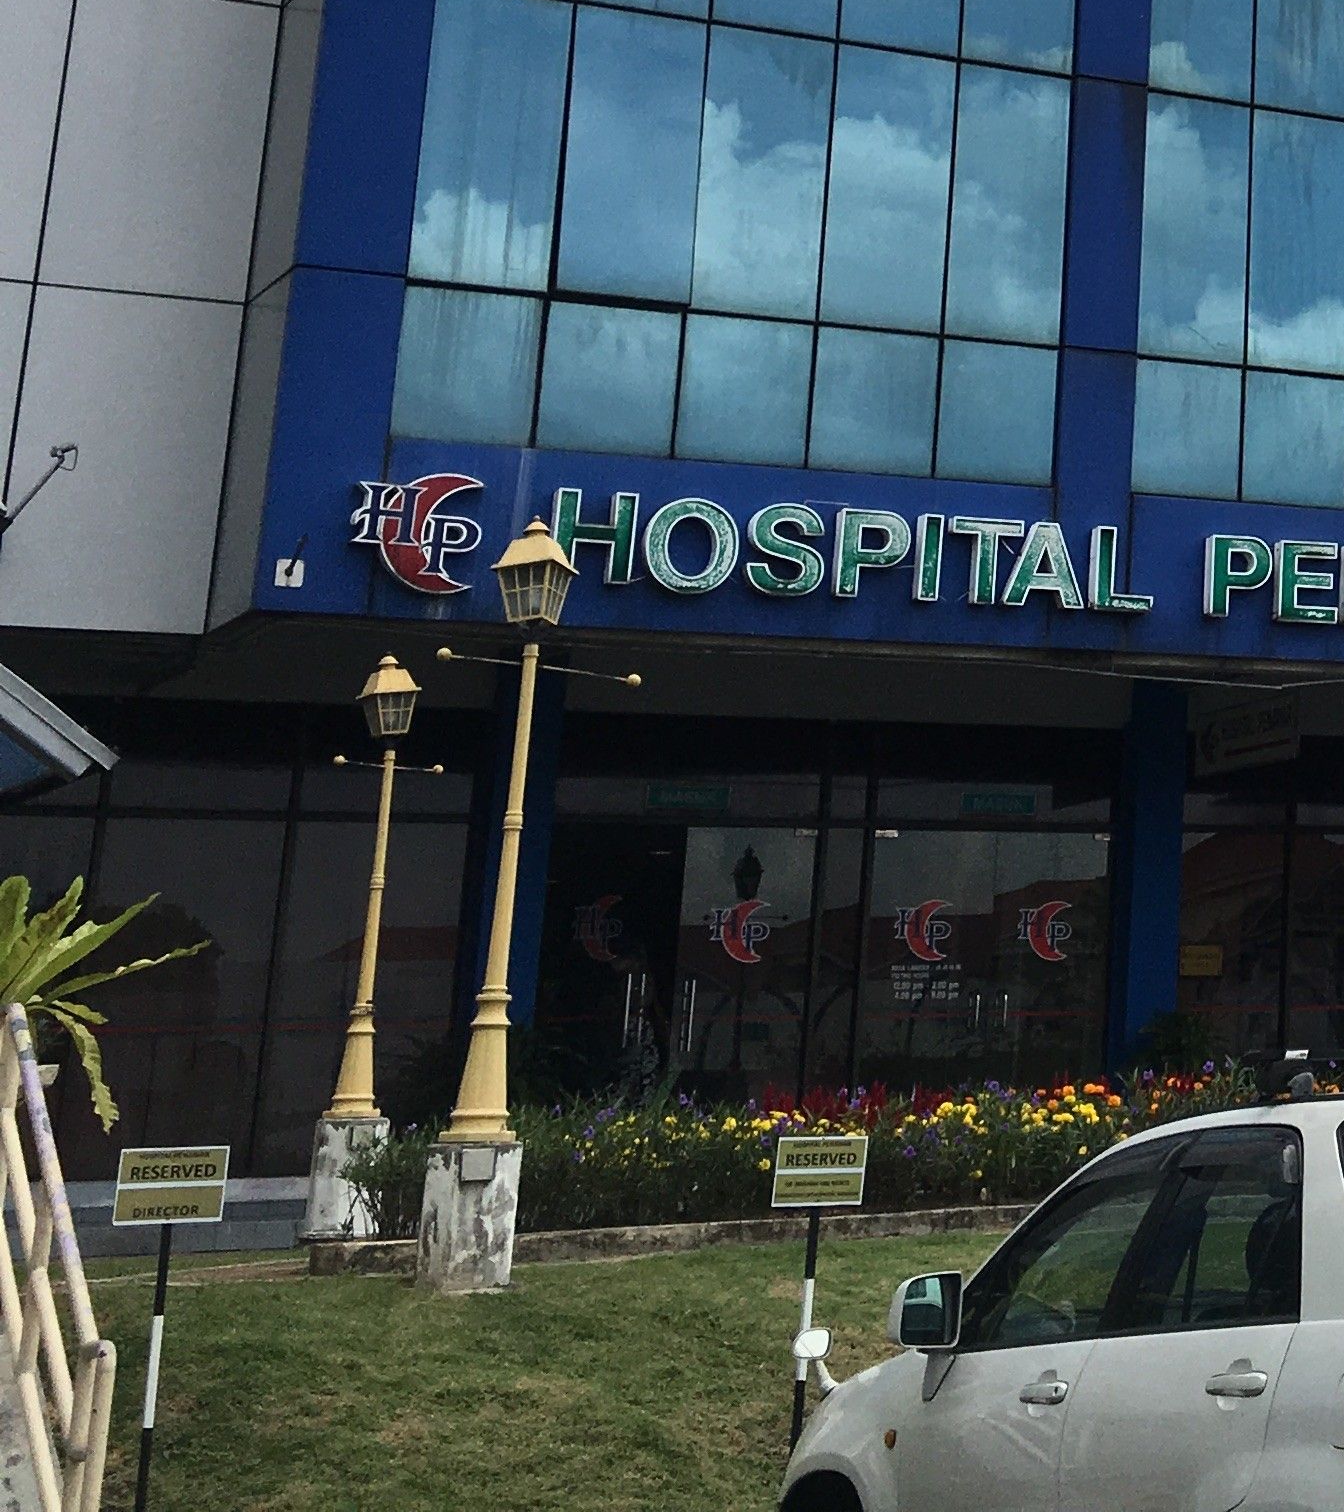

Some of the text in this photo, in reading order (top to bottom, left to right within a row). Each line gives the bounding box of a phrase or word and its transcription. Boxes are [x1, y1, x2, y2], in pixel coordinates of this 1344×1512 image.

[553, 487, 1153, 613] HOSPITAL
[785, 1152, 857, 1167] RESERVED
[130, 1164, 217, 1180] RESERVED
[132, 1205, 199, 1219] DIRECTOR
